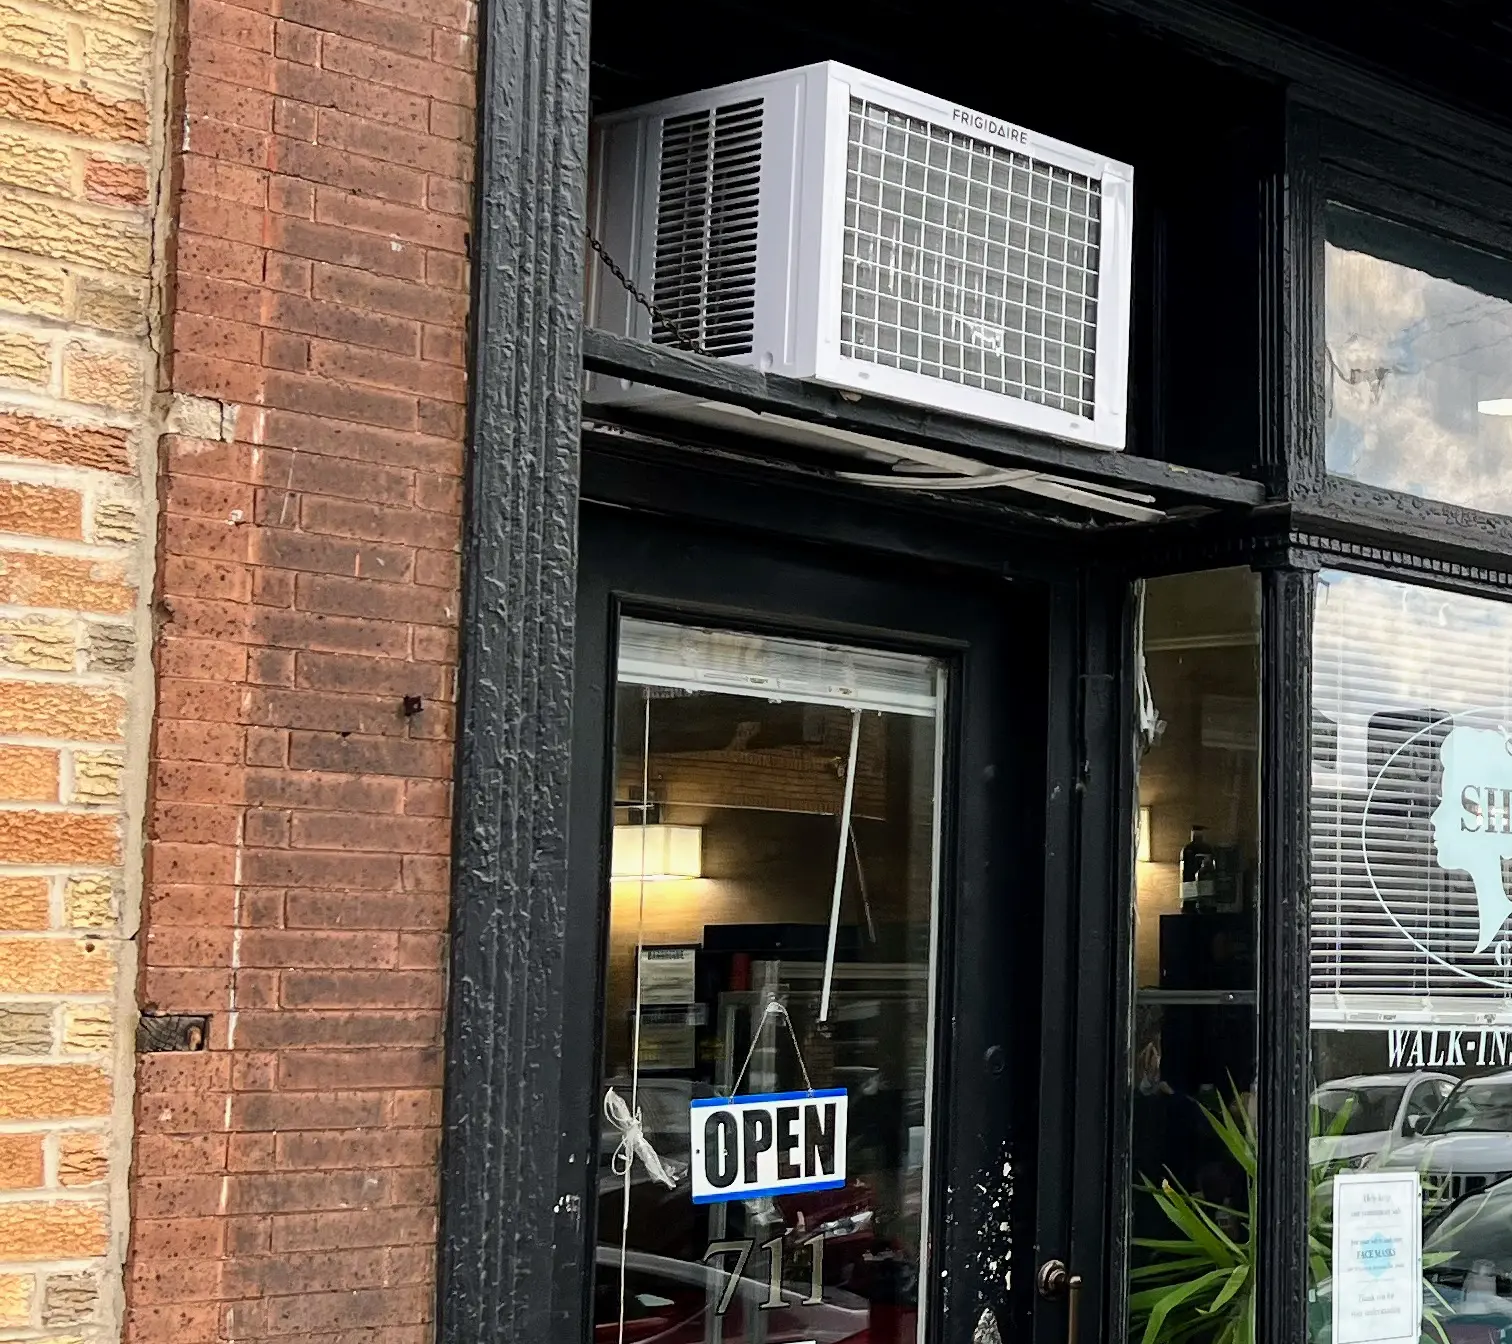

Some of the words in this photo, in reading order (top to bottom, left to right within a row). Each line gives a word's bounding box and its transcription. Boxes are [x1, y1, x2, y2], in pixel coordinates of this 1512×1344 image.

[952, 108, 1028, 145] FRIGIDAIRE
[704, 1102, 837, 1189] OPEN
[702, 1233, 825, 1316] 711
